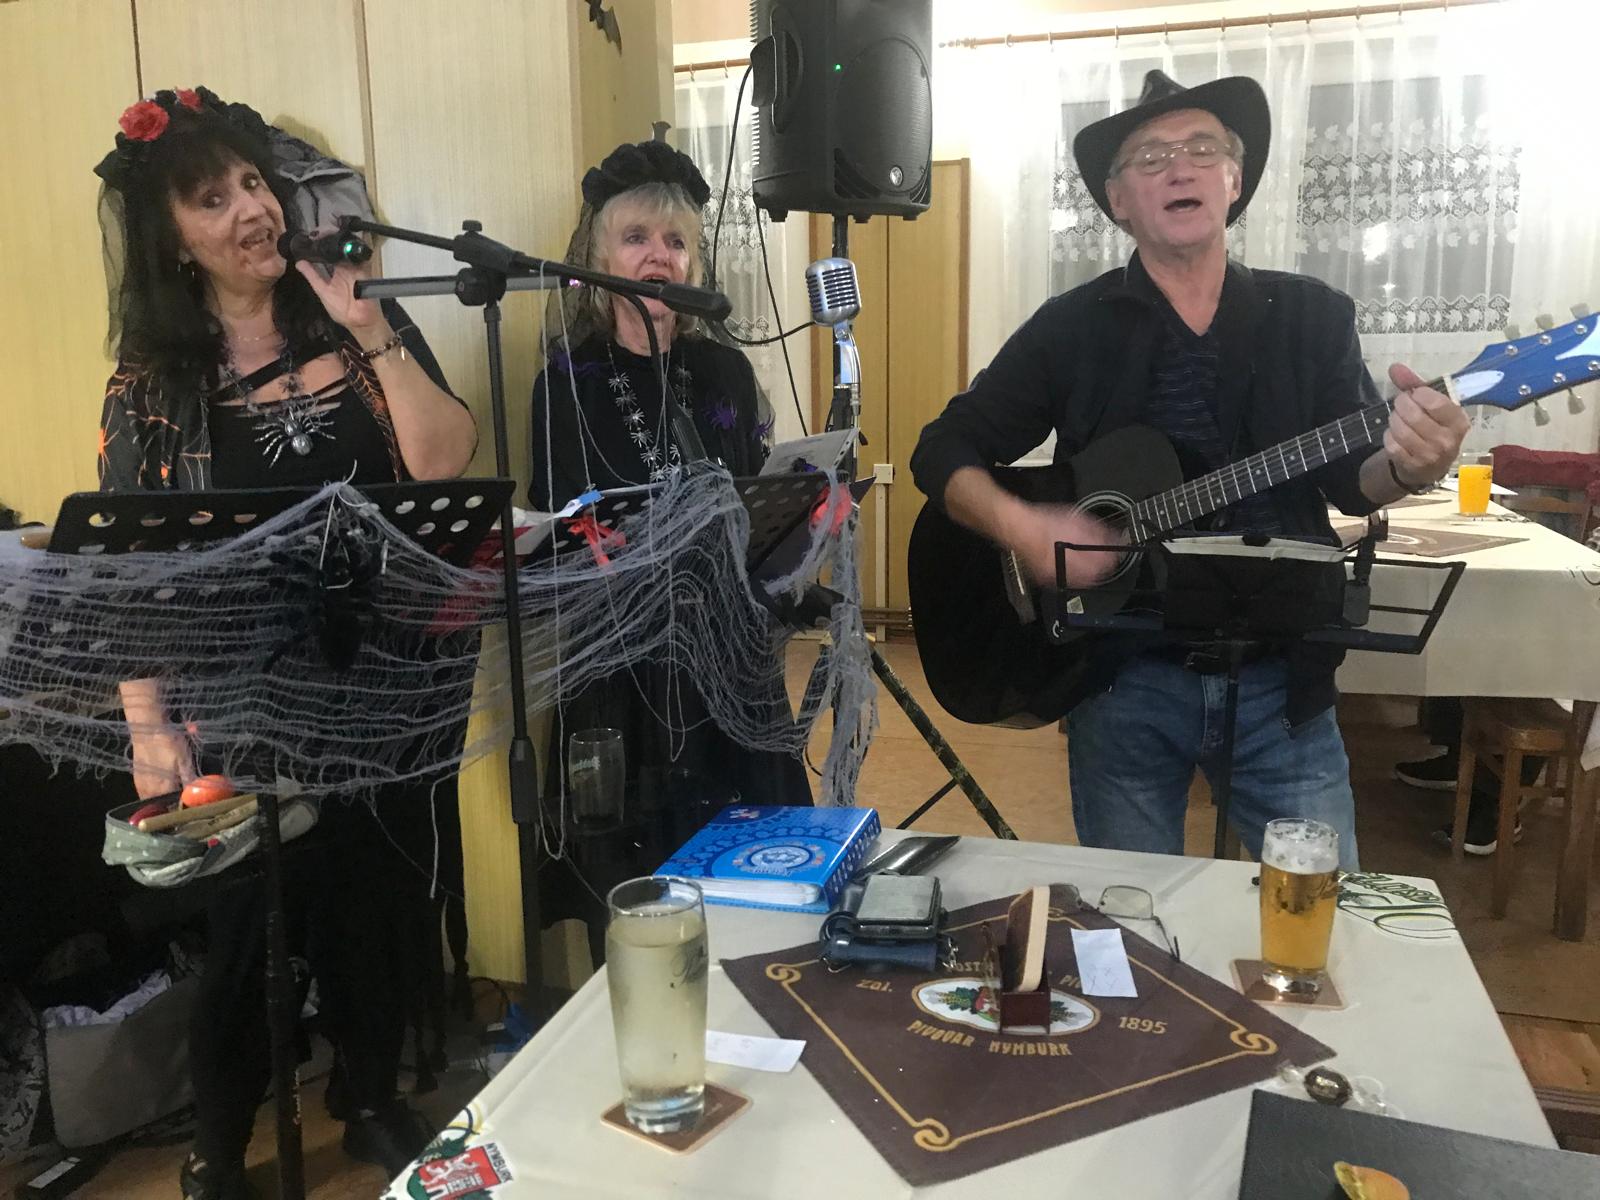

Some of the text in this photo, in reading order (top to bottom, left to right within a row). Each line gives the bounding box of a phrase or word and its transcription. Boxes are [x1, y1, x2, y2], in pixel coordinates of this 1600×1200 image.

[906, 1019, 1073, 1057] PIVOVAR NYMBURK
[1118, 1016, 1168, 1035] 1895
